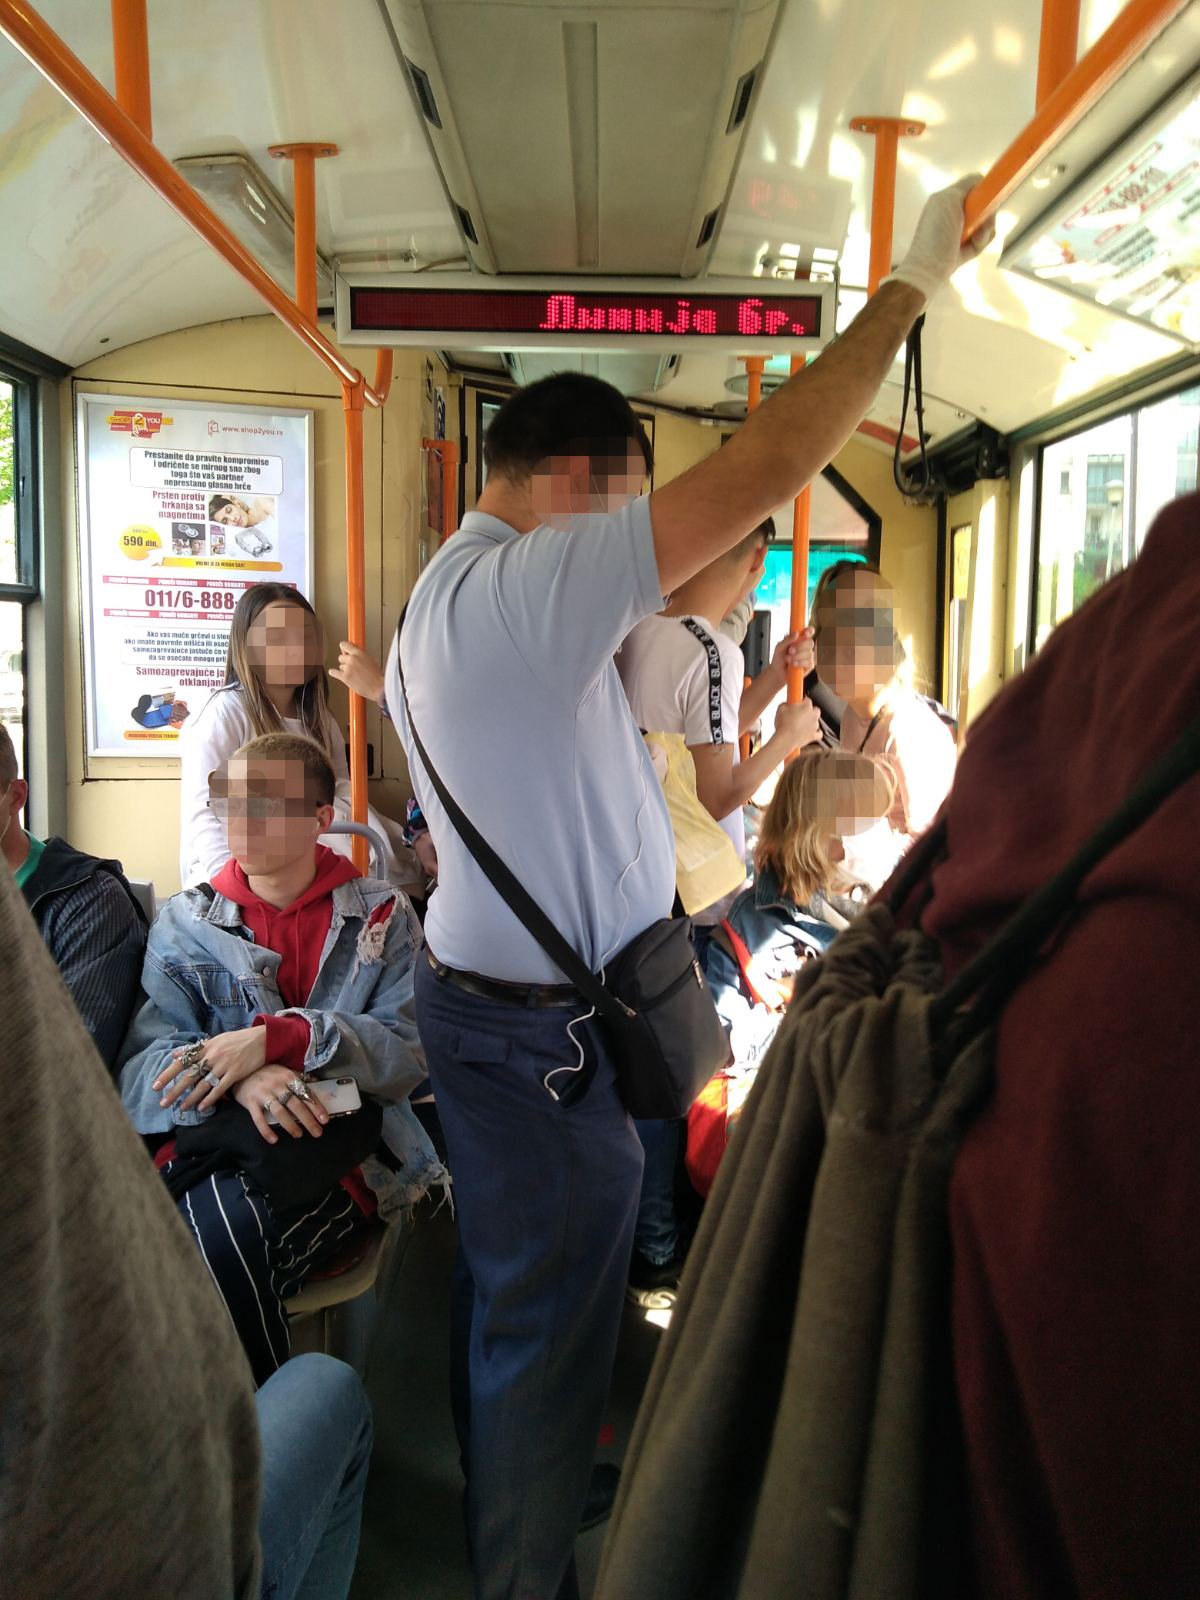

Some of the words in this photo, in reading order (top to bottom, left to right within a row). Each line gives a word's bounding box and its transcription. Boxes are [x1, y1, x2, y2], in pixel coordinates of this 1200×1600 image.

[222, 426, 284, 435] www.shop2you.rs
[144, 450, 183, 460] Prestanite
[185, 452, 195, 460] da
[196, 453, 222, 463] pravite
[223, 455, 269, 466] kompromise
[191, 462, 199, 470] se
[201, 463, 228, 472] mirnog
[229, 465, 242, 473] sna
[244, 465, 261, 475] zbog
[171, 470, 188, 479] toga
[189, 470, 201, 479] što
[202, 471, 215, 480] vaš
[217, 473, 244, 482] partner
[164, 479, 206, 488] neprestano
[208, 481, 233, 490] glasno
[235, 481, 251, 490] hrče
[152, 491, 179, 500] Prsten
[181, 492, 205, 501] protiv
[162, 501, 193, 511] hrkanja
[195, 503, 205, 511] sa
[158, 511, 205, 520] magnetima
[123, 536, 143, 546] 590
[145, 589, 238, 609] 011/6-888-
[708, 645, 721, 678] BLACK
[710, 685, 721, 721] BLACK
